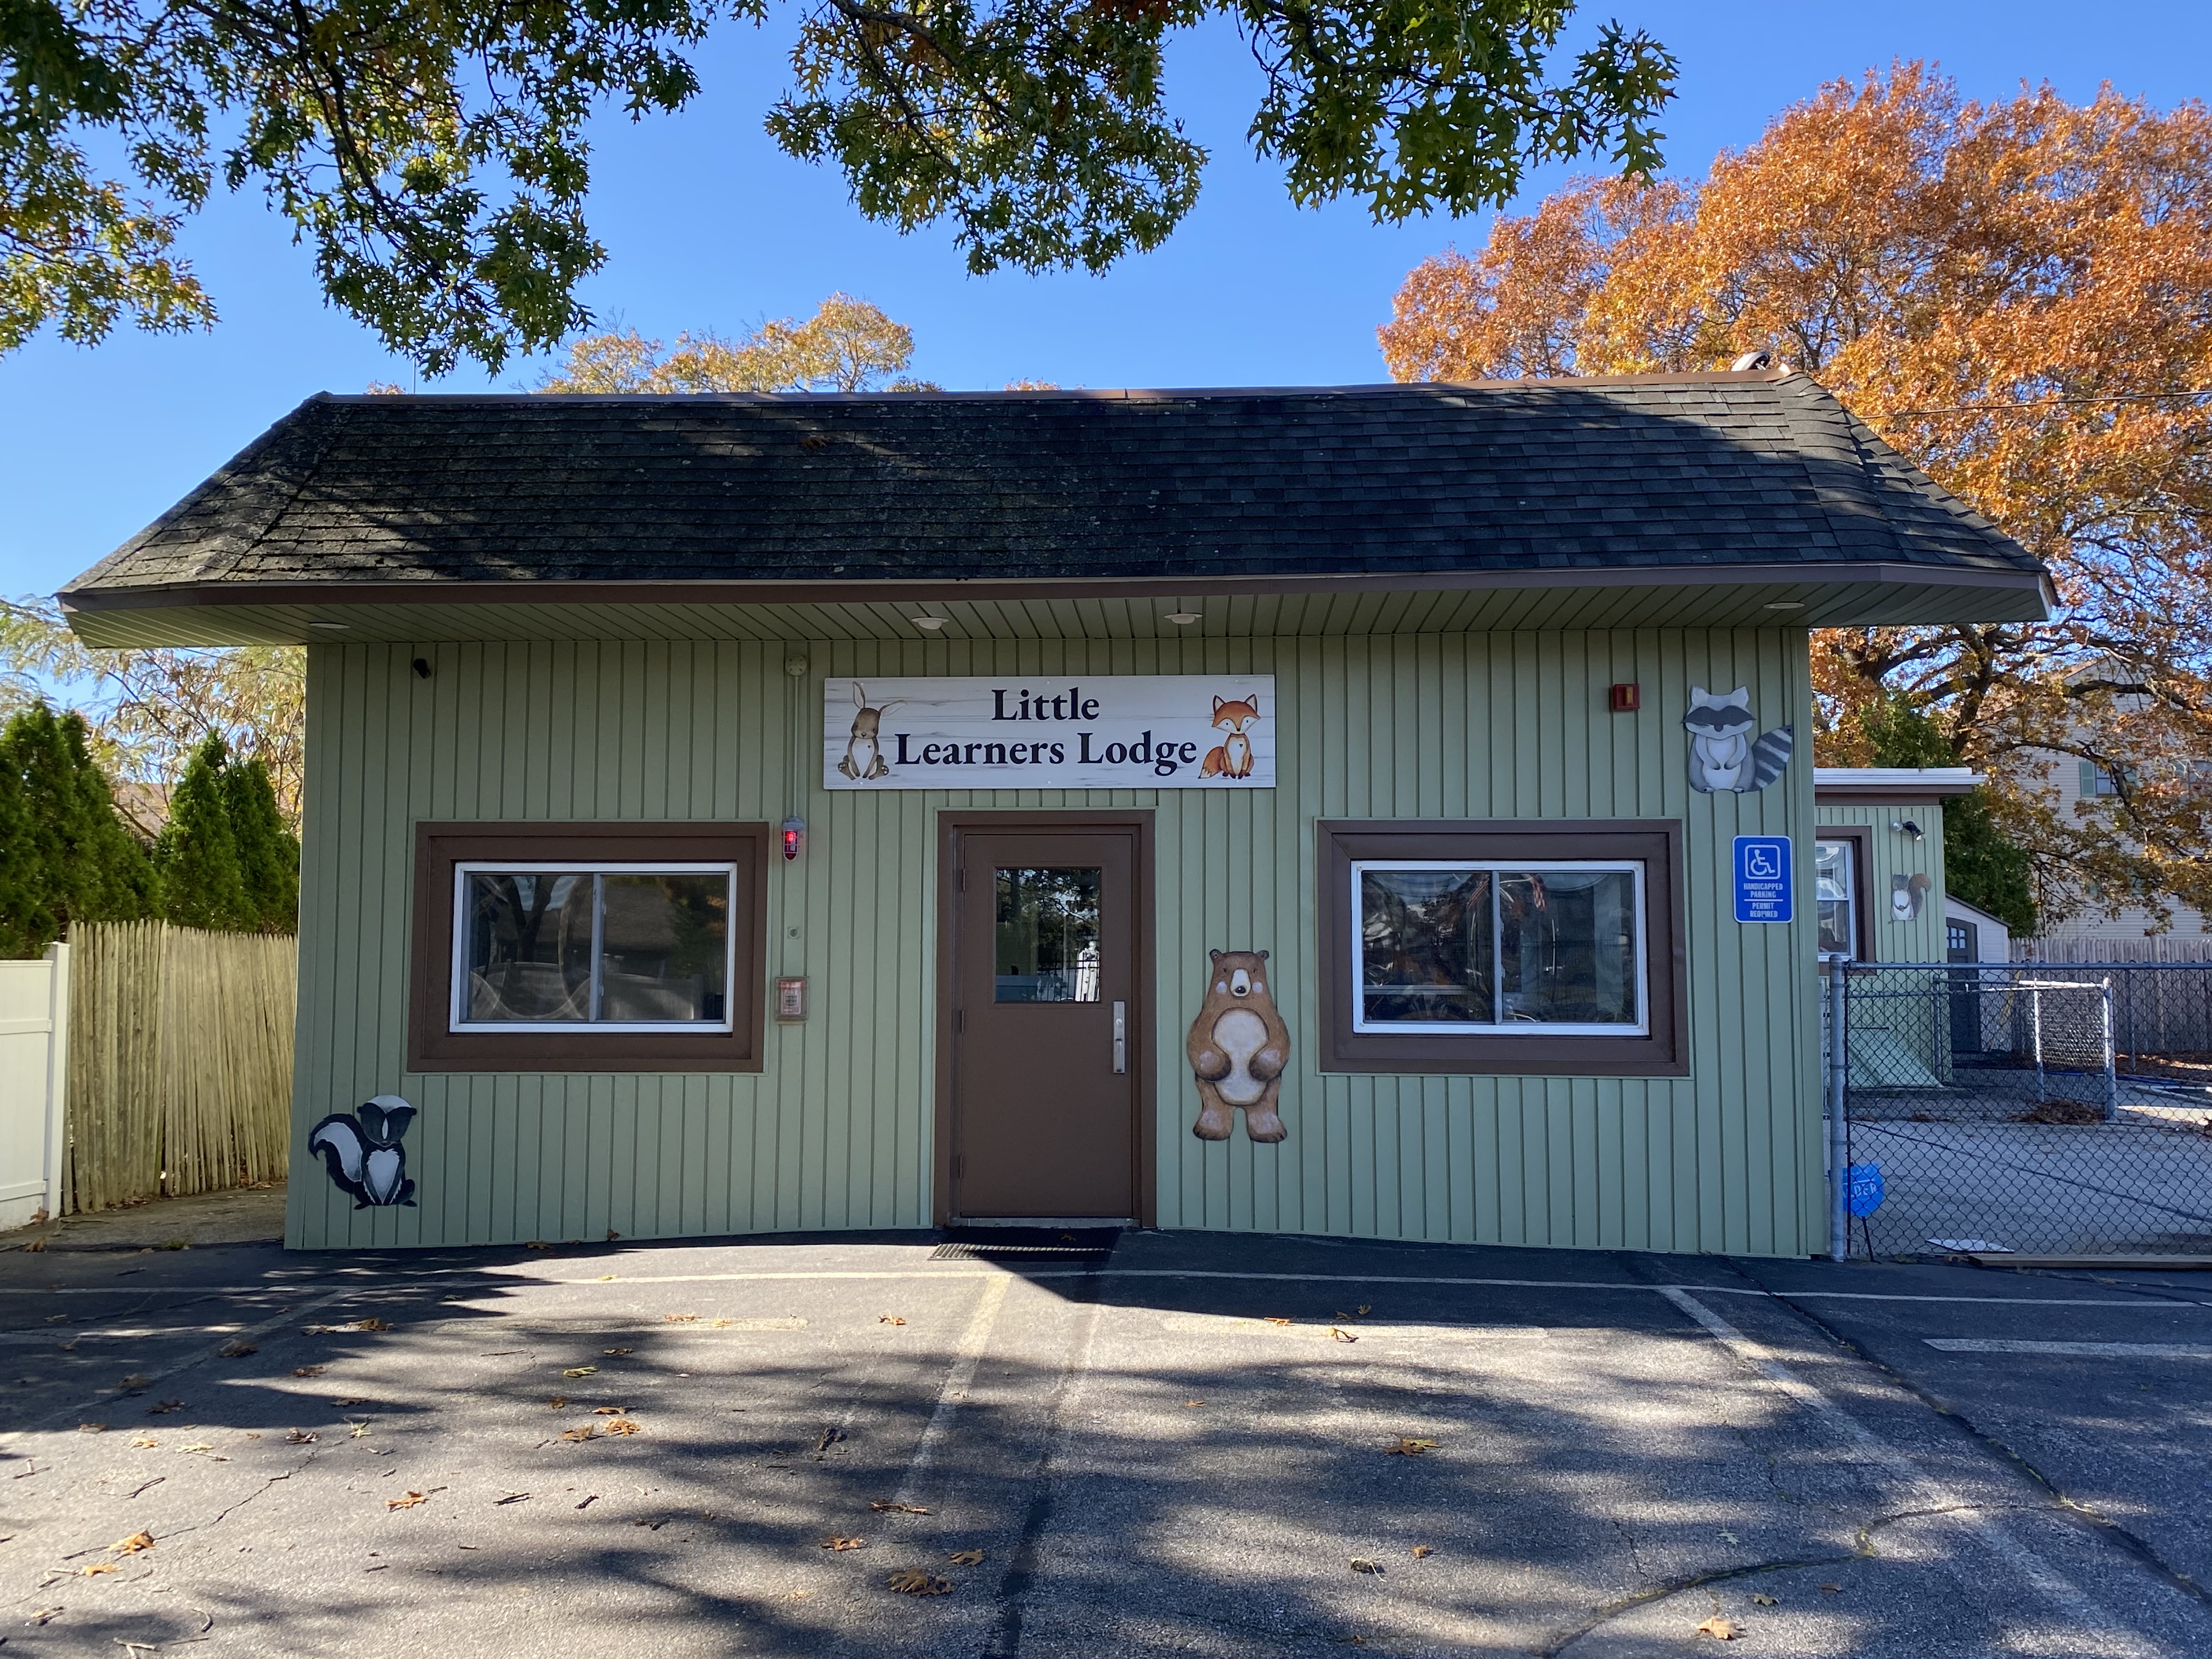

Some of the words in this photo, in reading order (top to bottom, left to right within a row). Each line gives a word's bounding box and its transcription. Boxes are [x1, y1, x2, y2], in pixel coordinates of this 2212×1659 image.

[991, 687, 1099, 720] Little
[895, 734, 1064, 764] Learners
[1077, 730, 1197, 776] Lodge
